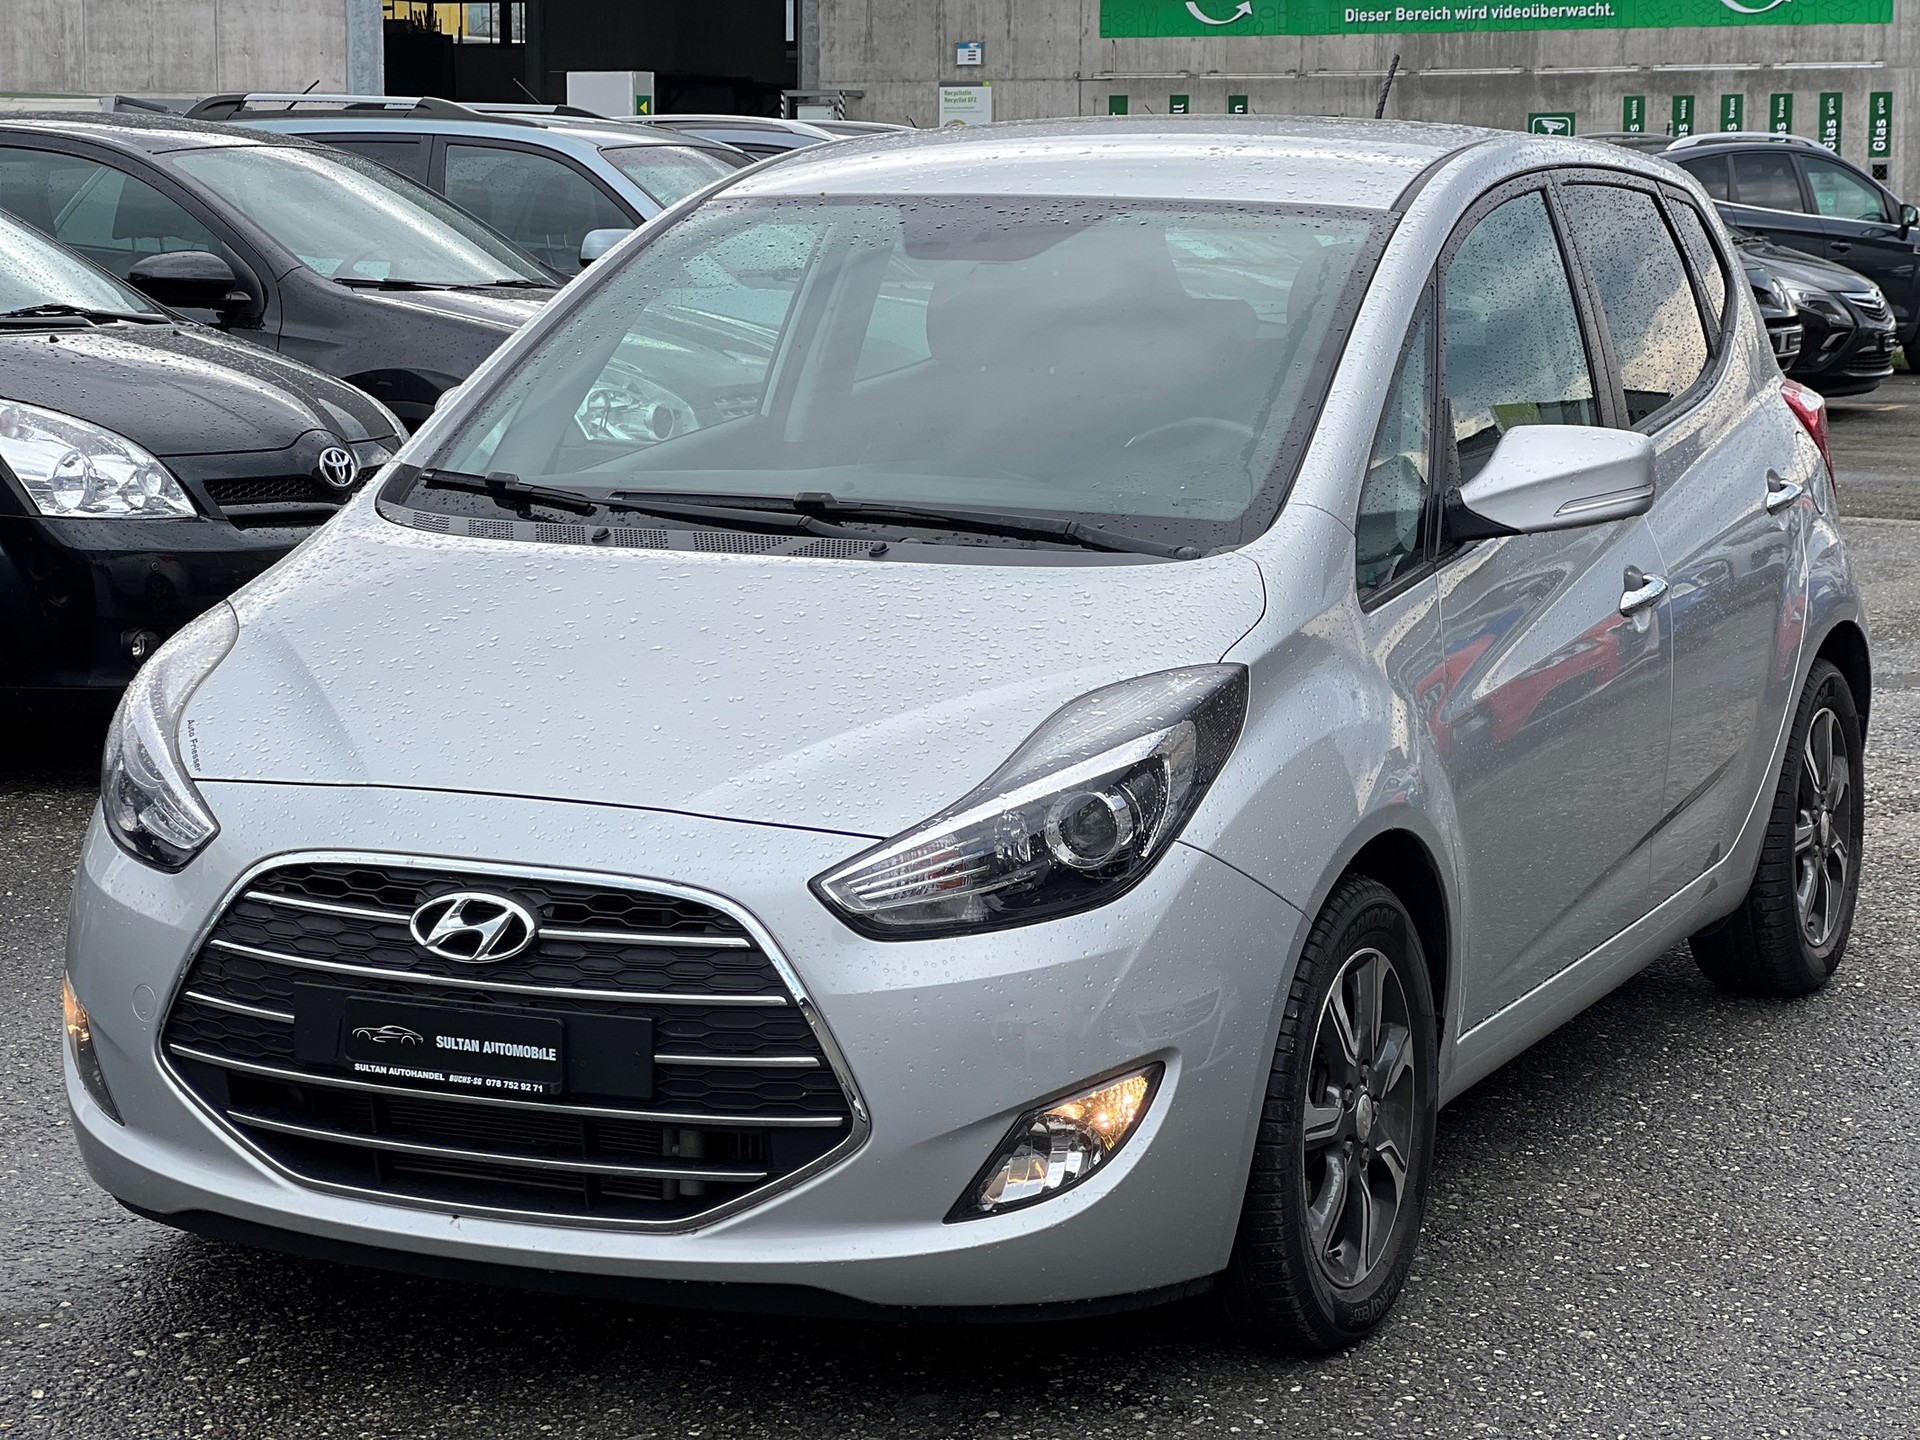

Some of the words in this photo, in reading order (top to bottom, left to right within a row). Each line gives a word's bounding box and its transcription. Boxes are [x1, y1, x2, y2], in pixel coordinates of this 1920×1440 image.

[1345, 7, 1391, 23] Dieser
[1395, 6, 1451, 21] Bereich
[1454, 4, 1488, 20] wird
[1490, 2, 1616, 19] videoüberwacht.
[1630, 100, 1639, 119] weiss
[1680, 99, 1688, 119] weiss
[1728, 98, 1736, 118] braun
[1777, 97, 1785, 117] braun
[1822, 119, 1837, 152] Glas
[1872, 119, 1887, 151] Glas
[187, 720, 196, 738] Auto
[190, 738, 202, 772] Friesser
[435, 1035, 480, 1053] SULTAN
[483, 1041, 557, 1061] AUTOMOBILE
[354, 1063, 387, 1074] SULTAN
[388, 1068, 445, 1081] AUTOHANDEL
[449, 1074, 483, 1085] BUCHS-SG
[485, 1079, 501, 1088] 078
[503, 1081, 519, 1090] 752
[520, 1083, 532, 1091] 92
